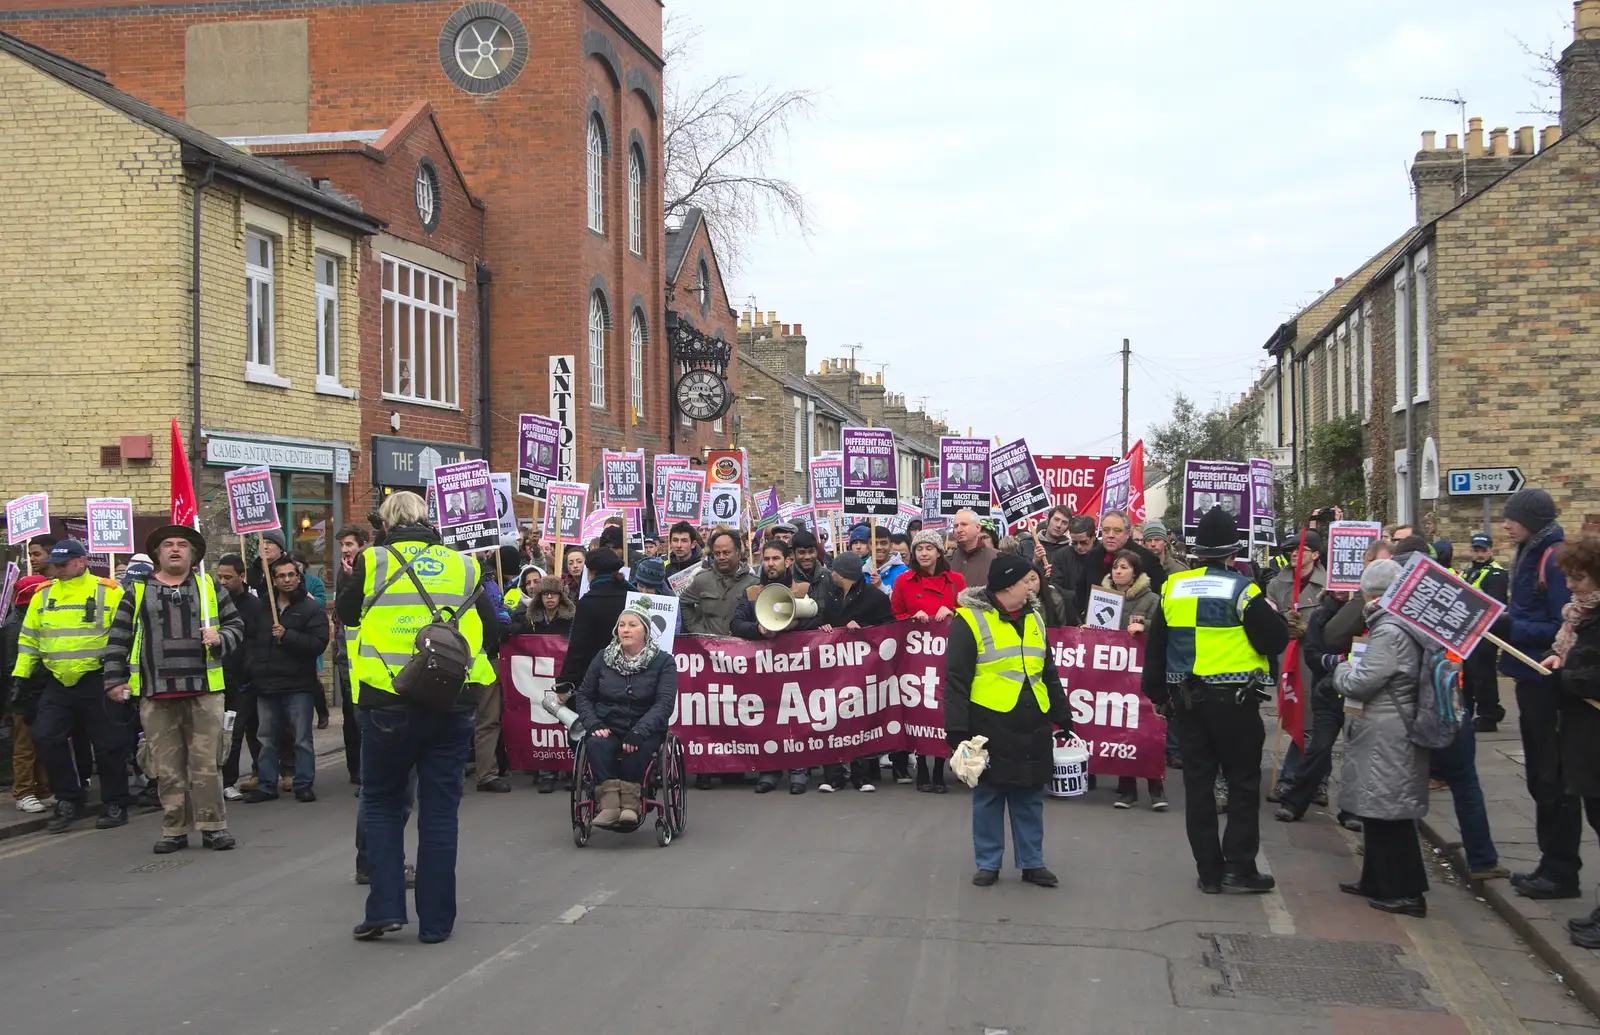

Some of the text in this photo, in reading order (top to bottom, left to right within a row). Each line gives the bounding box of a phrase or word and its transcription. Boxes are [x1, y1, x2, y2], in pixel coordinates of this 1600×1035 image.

[553, 358, 572, 482] ANTIQUE
[845, 438, 877, 446] DIFFERENT
[213, 443, 329, 465] CAMBS ANTIQUES CENTRE 01223
[1011, 445, 1027, 457] FACES
[392, 452, 413, 471] THE
[608, 461, 636, 472] SMASH
[1003, 453, 1027, 468] HATRED!
[438, 471, 471, 484] DIFFERENT
[608, 473, 641, 484] THE EDL
[814, 467, 837, 478] SMASH
[1188, 471, 1227, 481] DIFFERENT
[1228, 473, 1248, 482] FACES
[232, 481, 265, 496] SMASH
[442, 477, 488, 492] SAME HATRED!
[670, 480, 696, 492] SMASH
[814, 478, 828, 488] THE
[830, 477, 841, 487] EDL
[1192, 481, 1245, 491] SAME HATRED!
[609, 484, 635, 495] & BNP
[816, 488, 837, 498] & BNP
[925, 489, 940, 499] SMAS
[233, 492, 271, 508] THE EDL
[550, 494, 578, 507] SASH
[669, 491, 699, 503] THE EDL
[1009, 495, 1023, 506] RACIST
[1031, 493, 1046, 503] HERE!
[11, 502, 38, 518] SMASH
[236, 506, 265, 520] & BNP
[566, 507, 580, 519] EDL
[668, 502, 692, 513] & BNP
[12, 509, 44, 526] THE EDL
[92, 510, 122, 519] SMASH
[929, 510, 940, 518] BN
[12, 519, 37, 533] & BNP
[92, 520, 109, 530] THE
[112, 520, 128, 530] EDL
[456, 523, 485, 534] RACIST EDL
[548, 518, 554, 528] &
[93, 531, 101, 540] &
[103, 531, 121, 540] BNP
[444, 528, 498, 544] NOT WELCOME HERE!
[1333, 536, 1369, 549] SMASH
[435, 548, 450, 557] US
[1333, 549, 1352, 562] THE
[414, 561, 443, 574] pcs
[1332, 562, 1364, 575] & BNP
[1400, 576, 1441, 618] SMASH
[630, 600, 673, 612] CARIDGE:
[1417, 583, 1463, 629] THE EDL
[395, 616, 415, 624] 0800
[1443, 601, 1471, 629] BNP
[1434, 625, 1455, 640] &
[674, 630, 948, 678] op the Nazi BNP Sto
[1092, 644, 1143, 673] EDL
[776, 666, 940, 732] Against
[689, 741, 703, 755] to
[708, 741, 760, 755] racism
[783, 739, 804, 753] No
[808, 737, 824, 750] to
[828, 725, 883, 748] fascism
[532, 750, 565, 760] against
[1100, 741, 1137, 760] 2782
